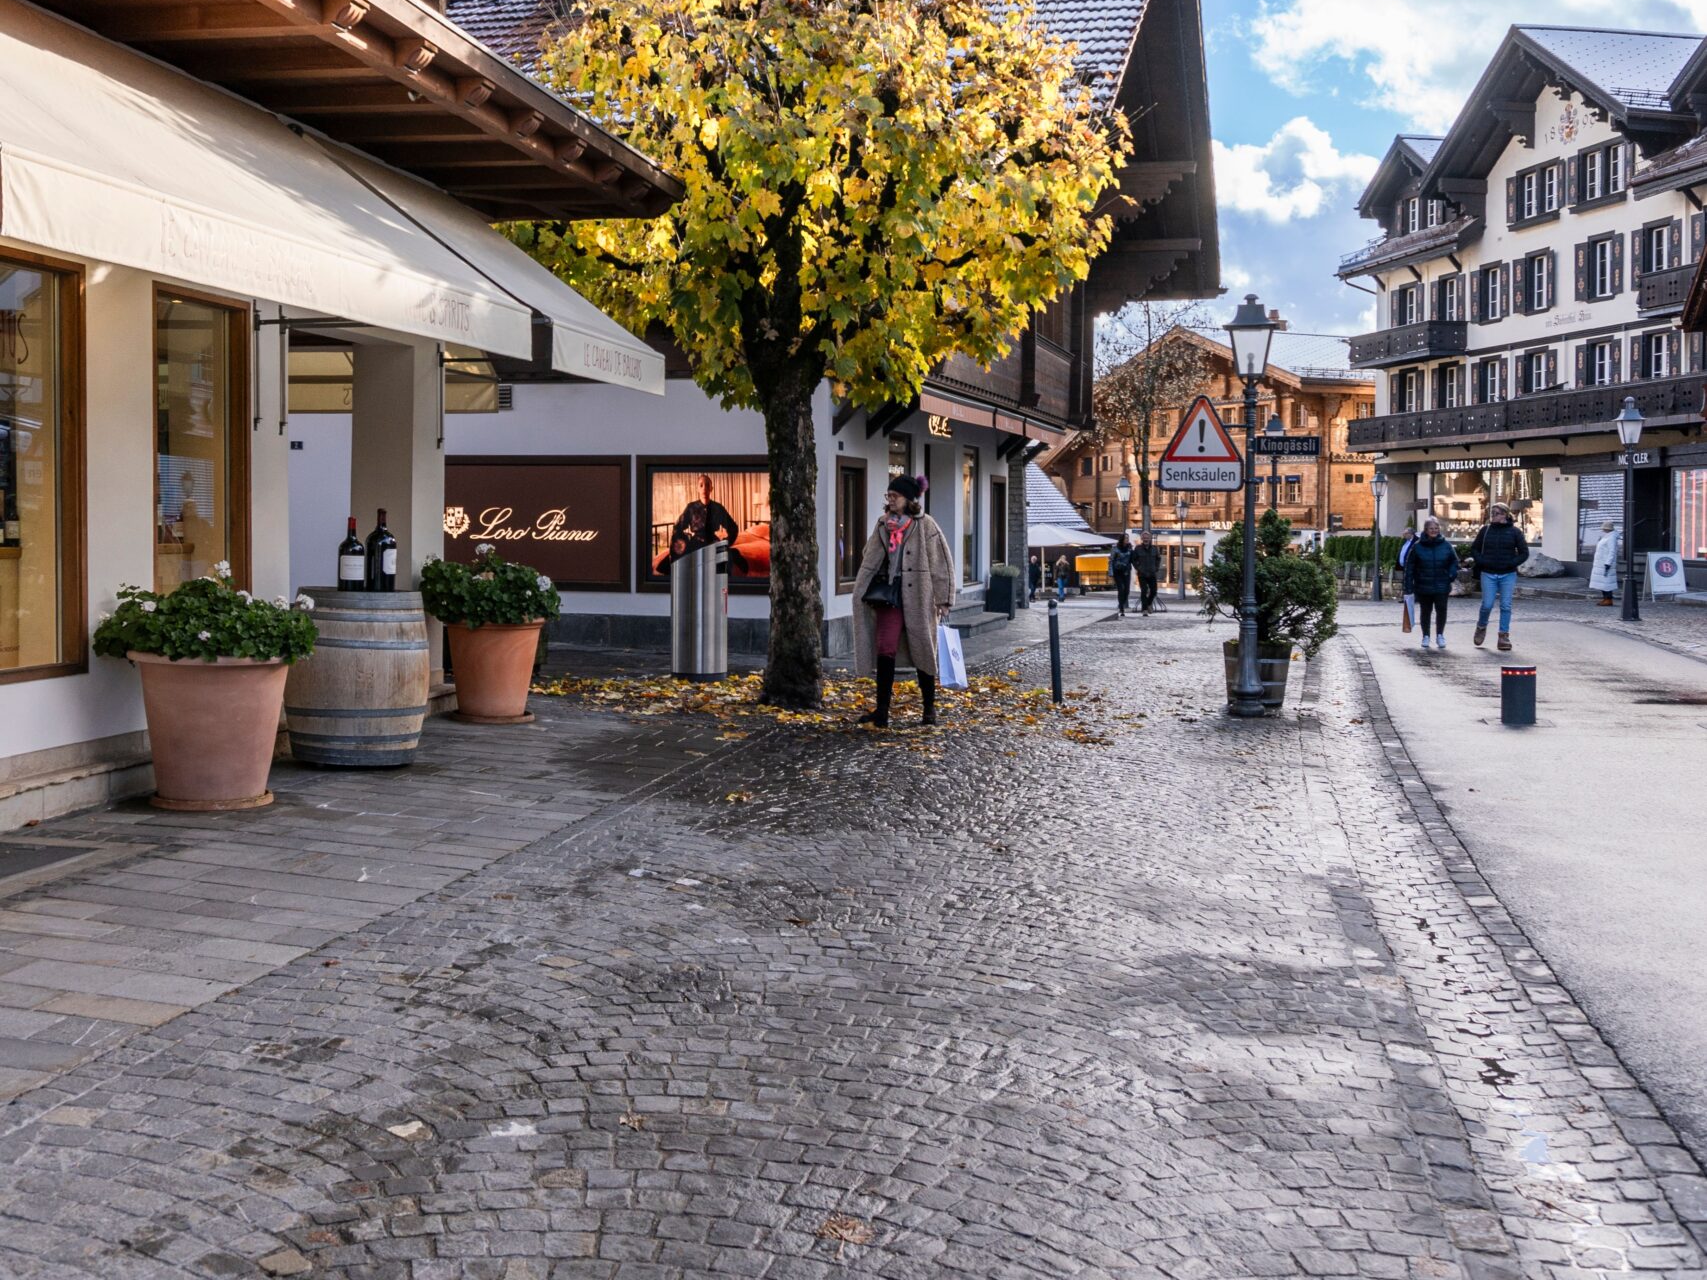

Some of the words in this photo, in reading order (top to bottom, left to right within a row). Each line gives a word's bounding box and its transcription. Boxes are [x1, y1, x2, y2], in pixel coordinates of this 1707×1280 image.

[438, 298, 471, 332] SPIRITS
[1260, 438, 1316, 454] Kinogässli
[1435, 460, 1475, 471] BRUNELLO
[1476, 457, 1521, 469] CUCINELLI
[1165, 467, 1236, 482] Senksäulen
[469, 507, 531, 540] Loro
[531, 505, 599, 541] Piana
[1209, 521, 1235, 530] PRAD
